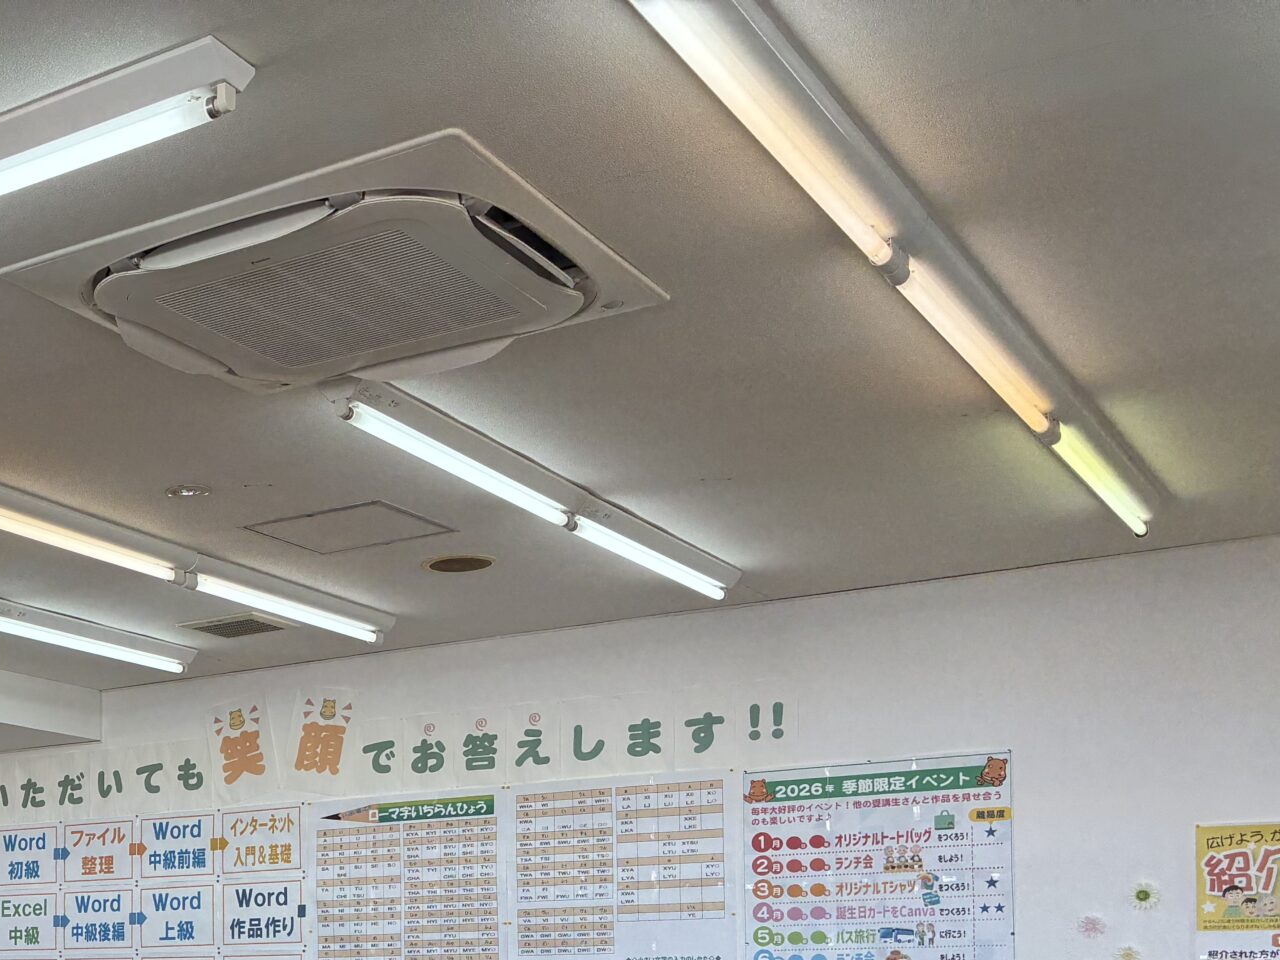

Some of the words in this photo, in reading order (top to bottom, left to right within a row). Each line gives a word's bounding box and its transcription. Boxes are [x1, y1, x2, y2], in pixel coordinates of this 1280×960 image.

[775, 782, 835, 798] 2026年
[842, 773, 971, 795] 季節限定イベント
[369, 801, 487, 820] ローマ字いちらんひょう
[975, 810, 1006, 820] 難易度
[153, 819, 202, 840] Word
[230, 812, 295, 837] インターネット
[3, 833, 46, 852] Word
[71, 826, 125, 847] ファイル
[835, 828, 932, 847] オリジナルトートバッグ
[937, 832, 969, 842] をつくろう!
[148, 848, 206, 871] 中級前編
[233, 843, 292, 867] 入門&基礎
[835, 854, 874, 870] ランチ会
[937, 854, 964, 863] をしよう!
[8, 860, 40, 880] 初級
[81, 855, 114, 876] 整理
[235, 887, 288, 908] Word
[835, 880, 916, 896] オリジナルTシャツ
[938, 883, 970, 892] をつくろう!
[1, 899, 47, 917] Excel
[75, 894, 121, 913] Word
[153, 891, 201, 911] Word
[835, 905, 936, 920] 誕生日カードをCanva
[939, 908, 971, 916] でつくろう!
[8, 927, 40, 946] 中級
[71, 922, 125, 942] 中級後編
[159, 921, 195, 941] 上級
[230, 917, 295, 939] 作品作り
[836, 927, 877, 943] バス旅行
[939, 930, 966, 939] に行こう!
